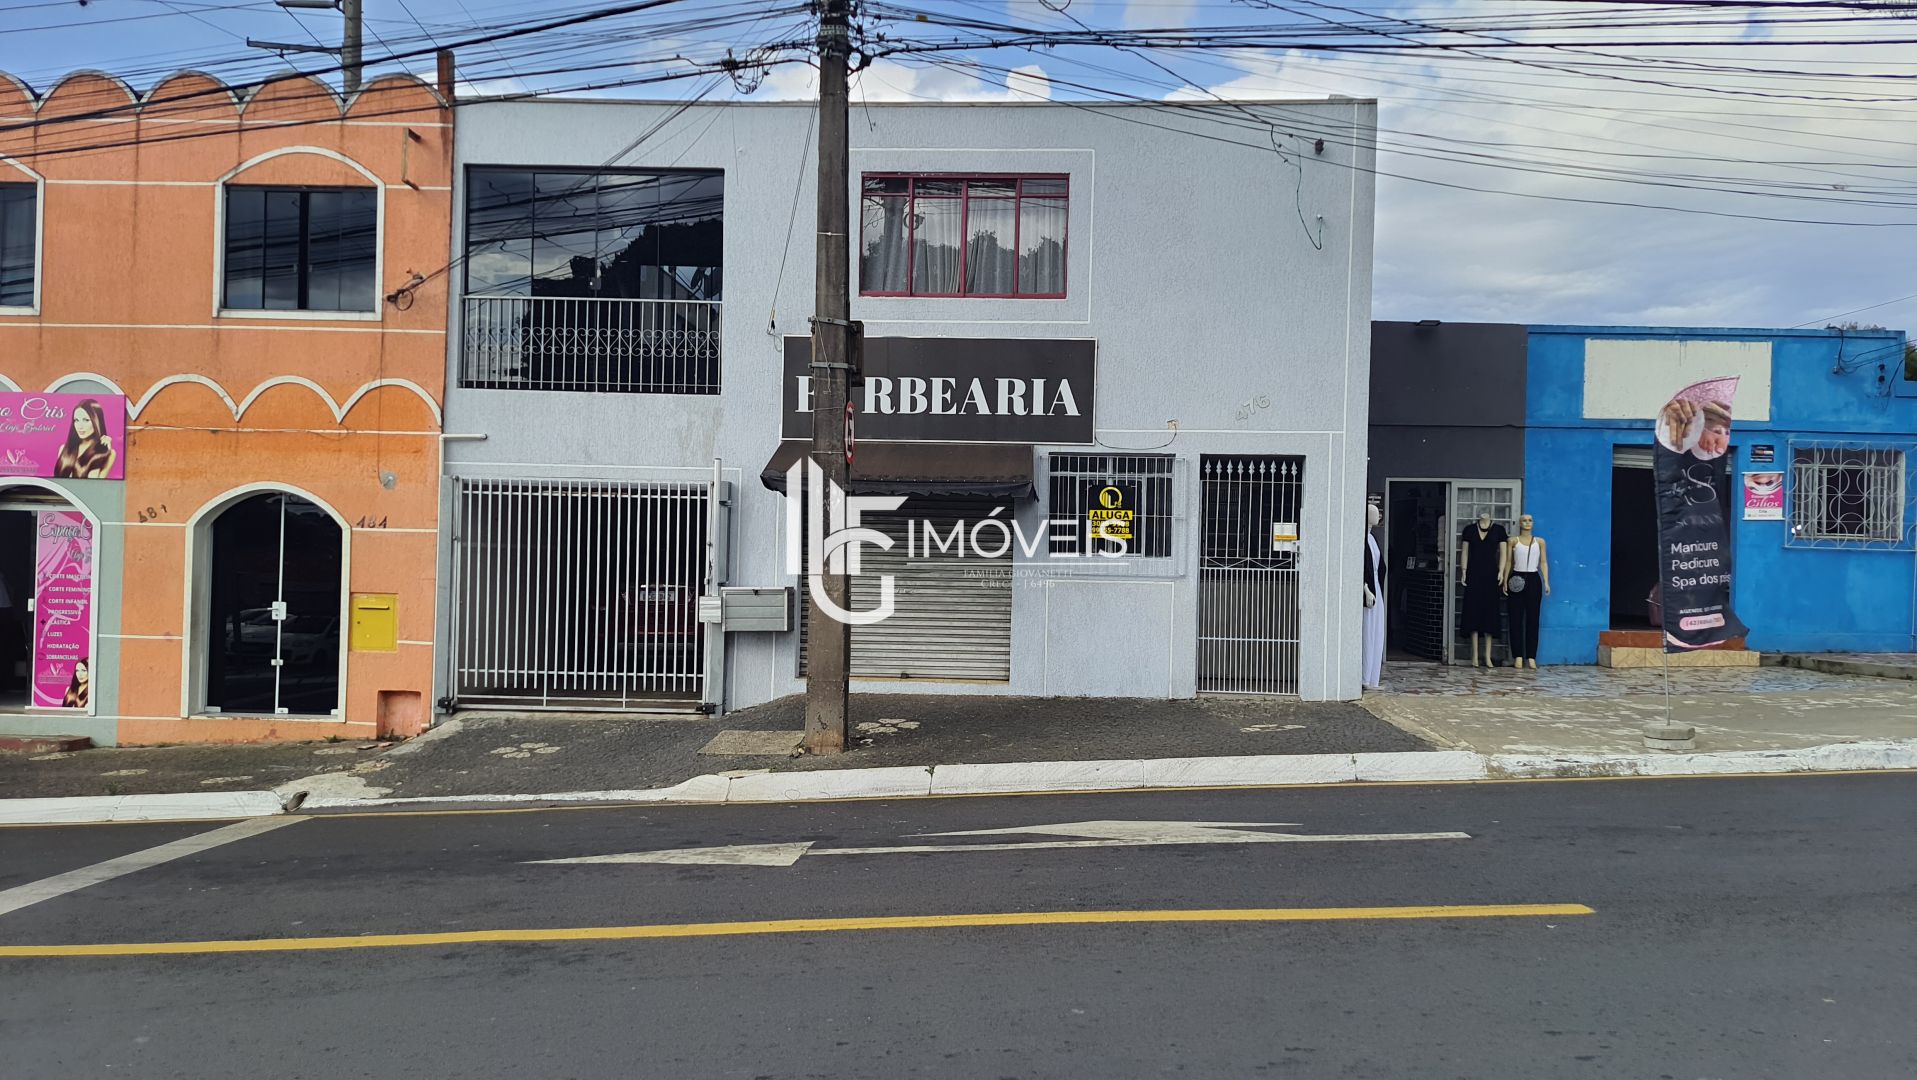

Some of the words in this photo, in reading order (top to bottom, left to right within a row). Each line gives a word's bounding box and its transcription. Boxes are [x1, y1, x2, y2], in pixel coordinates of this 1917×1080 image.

[795, 375, 1081, 417] BRBEARIA
[20, 397, 65, 420] Cris
[1092, 511, 1130, 519] ALUGA
[1671, 541, 1719, 554] Manicure
[1672, 557, 1720, 571] Pedicure
[1672, 575, 1697, 590] Spa
[1700, 573, 1718, 585] dos
[46, 642, 80, 650] HIDRATAÇÃO
